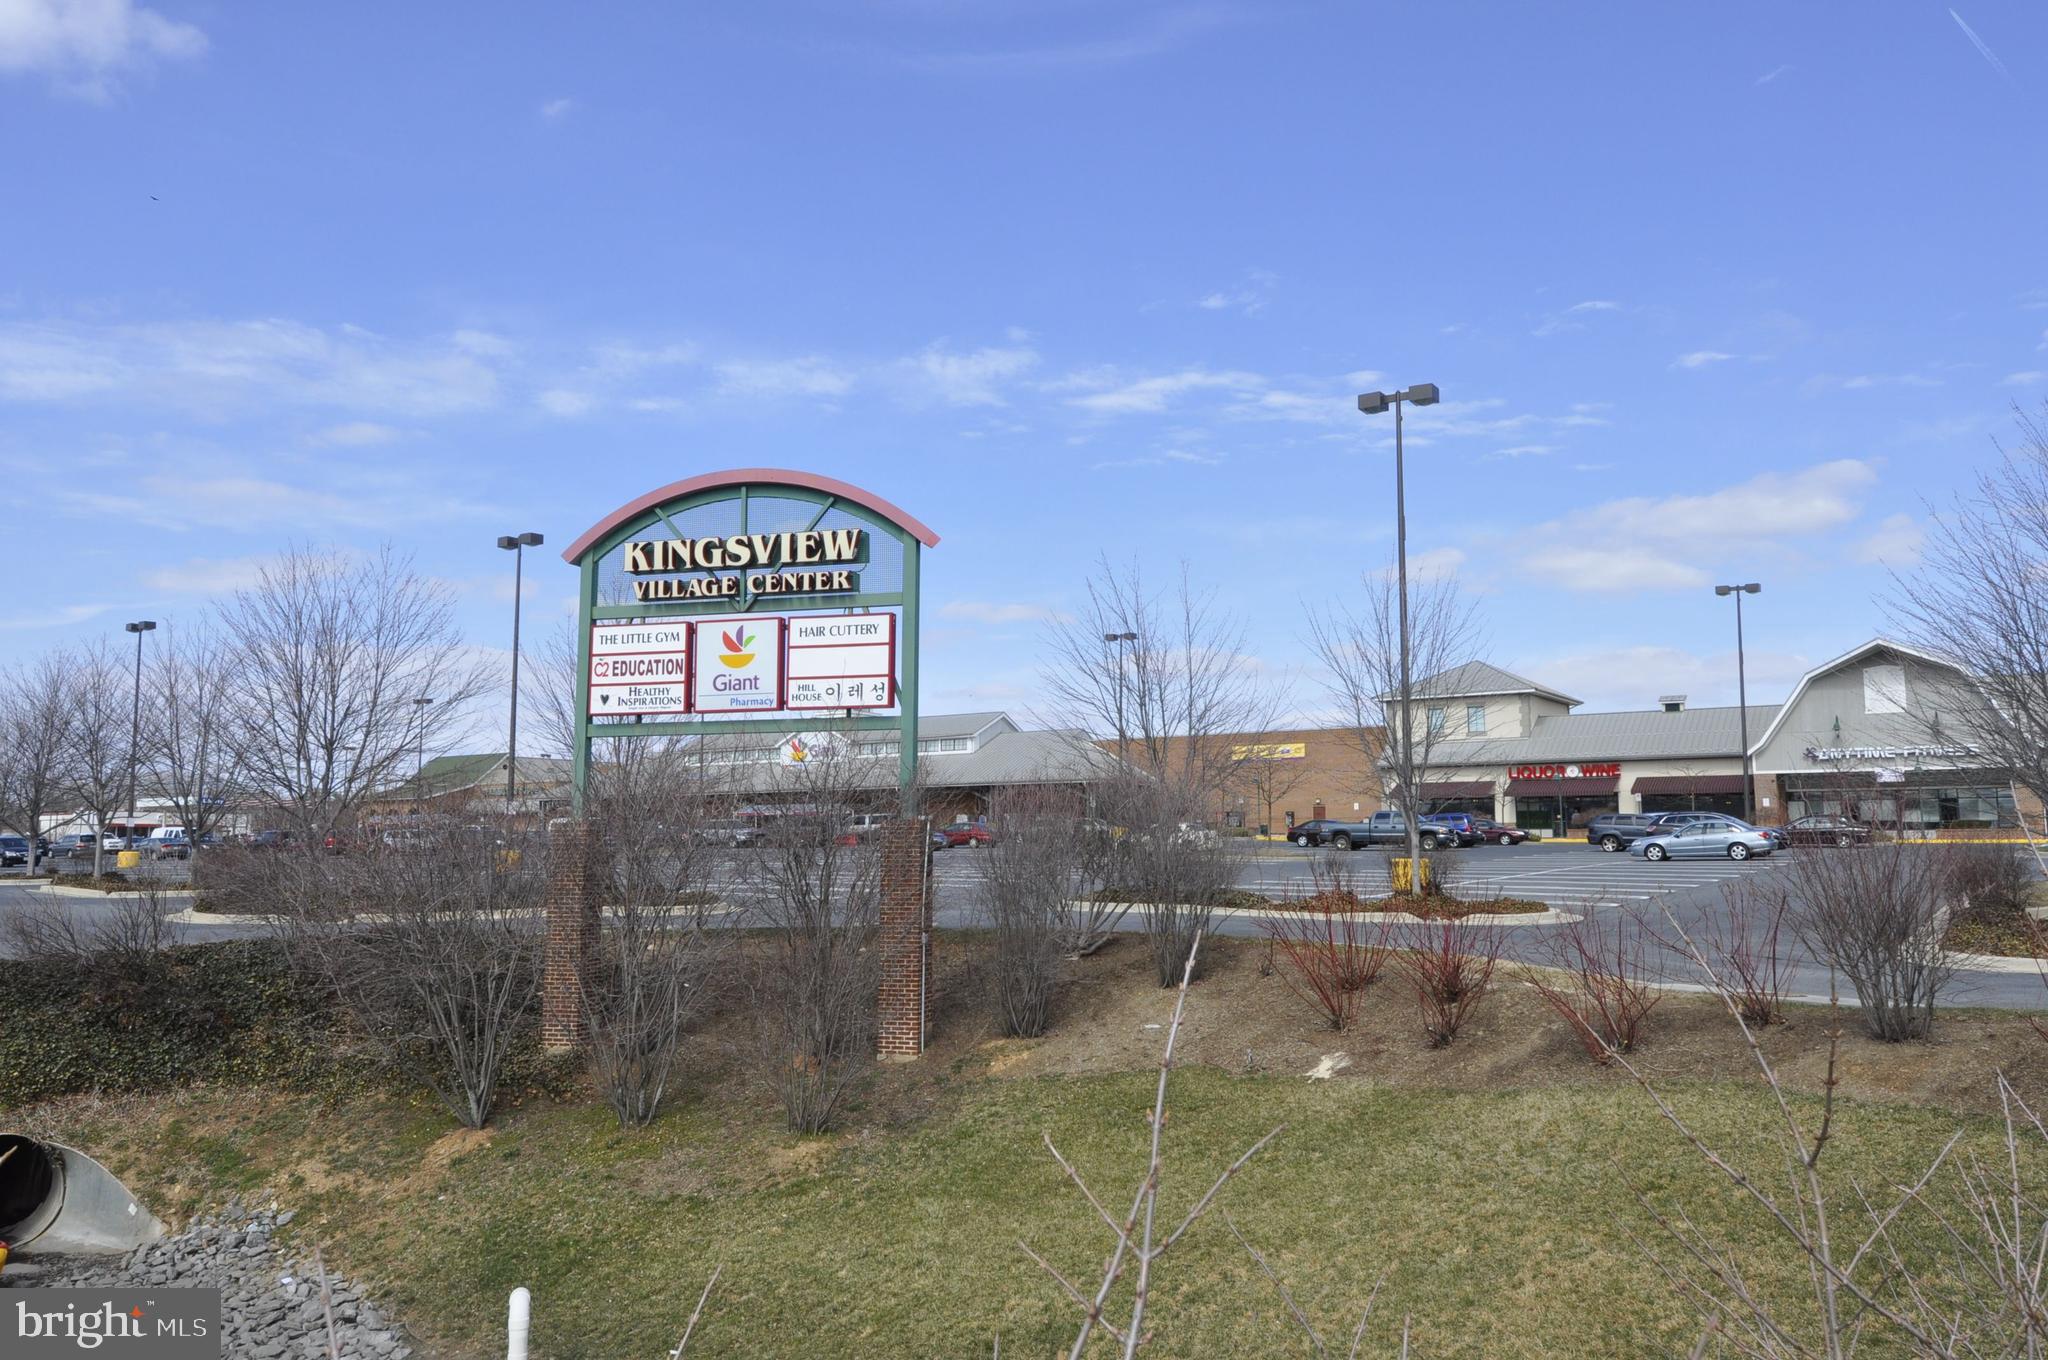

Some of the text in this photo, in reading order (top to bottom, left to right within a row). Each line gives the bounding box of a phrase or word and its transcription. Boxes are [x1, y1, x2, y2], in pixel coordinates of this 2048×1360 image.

[624, 528, 861, 572] KINGSVIEW
[632, 570, 851, 600] VILLAGE CENTER
[799, 623, 880, 638] HAIR CUTTERY
[600, 631, 680, 645] THE LITTLE GYM
[612, 658, 684, 677] EDUCATION
[712, 674, 760, 692] Giant
[797, 684, 816, 692] HILL
[628, 687, 671, 697] HEALTHY
[791, 693, 822, 702] HOUSE
[617, 696, 682, 706] INSPIRATIONS
[730, 697, 774, 707] Pharmacy
[1580, 763, 1622, 777] WINE
